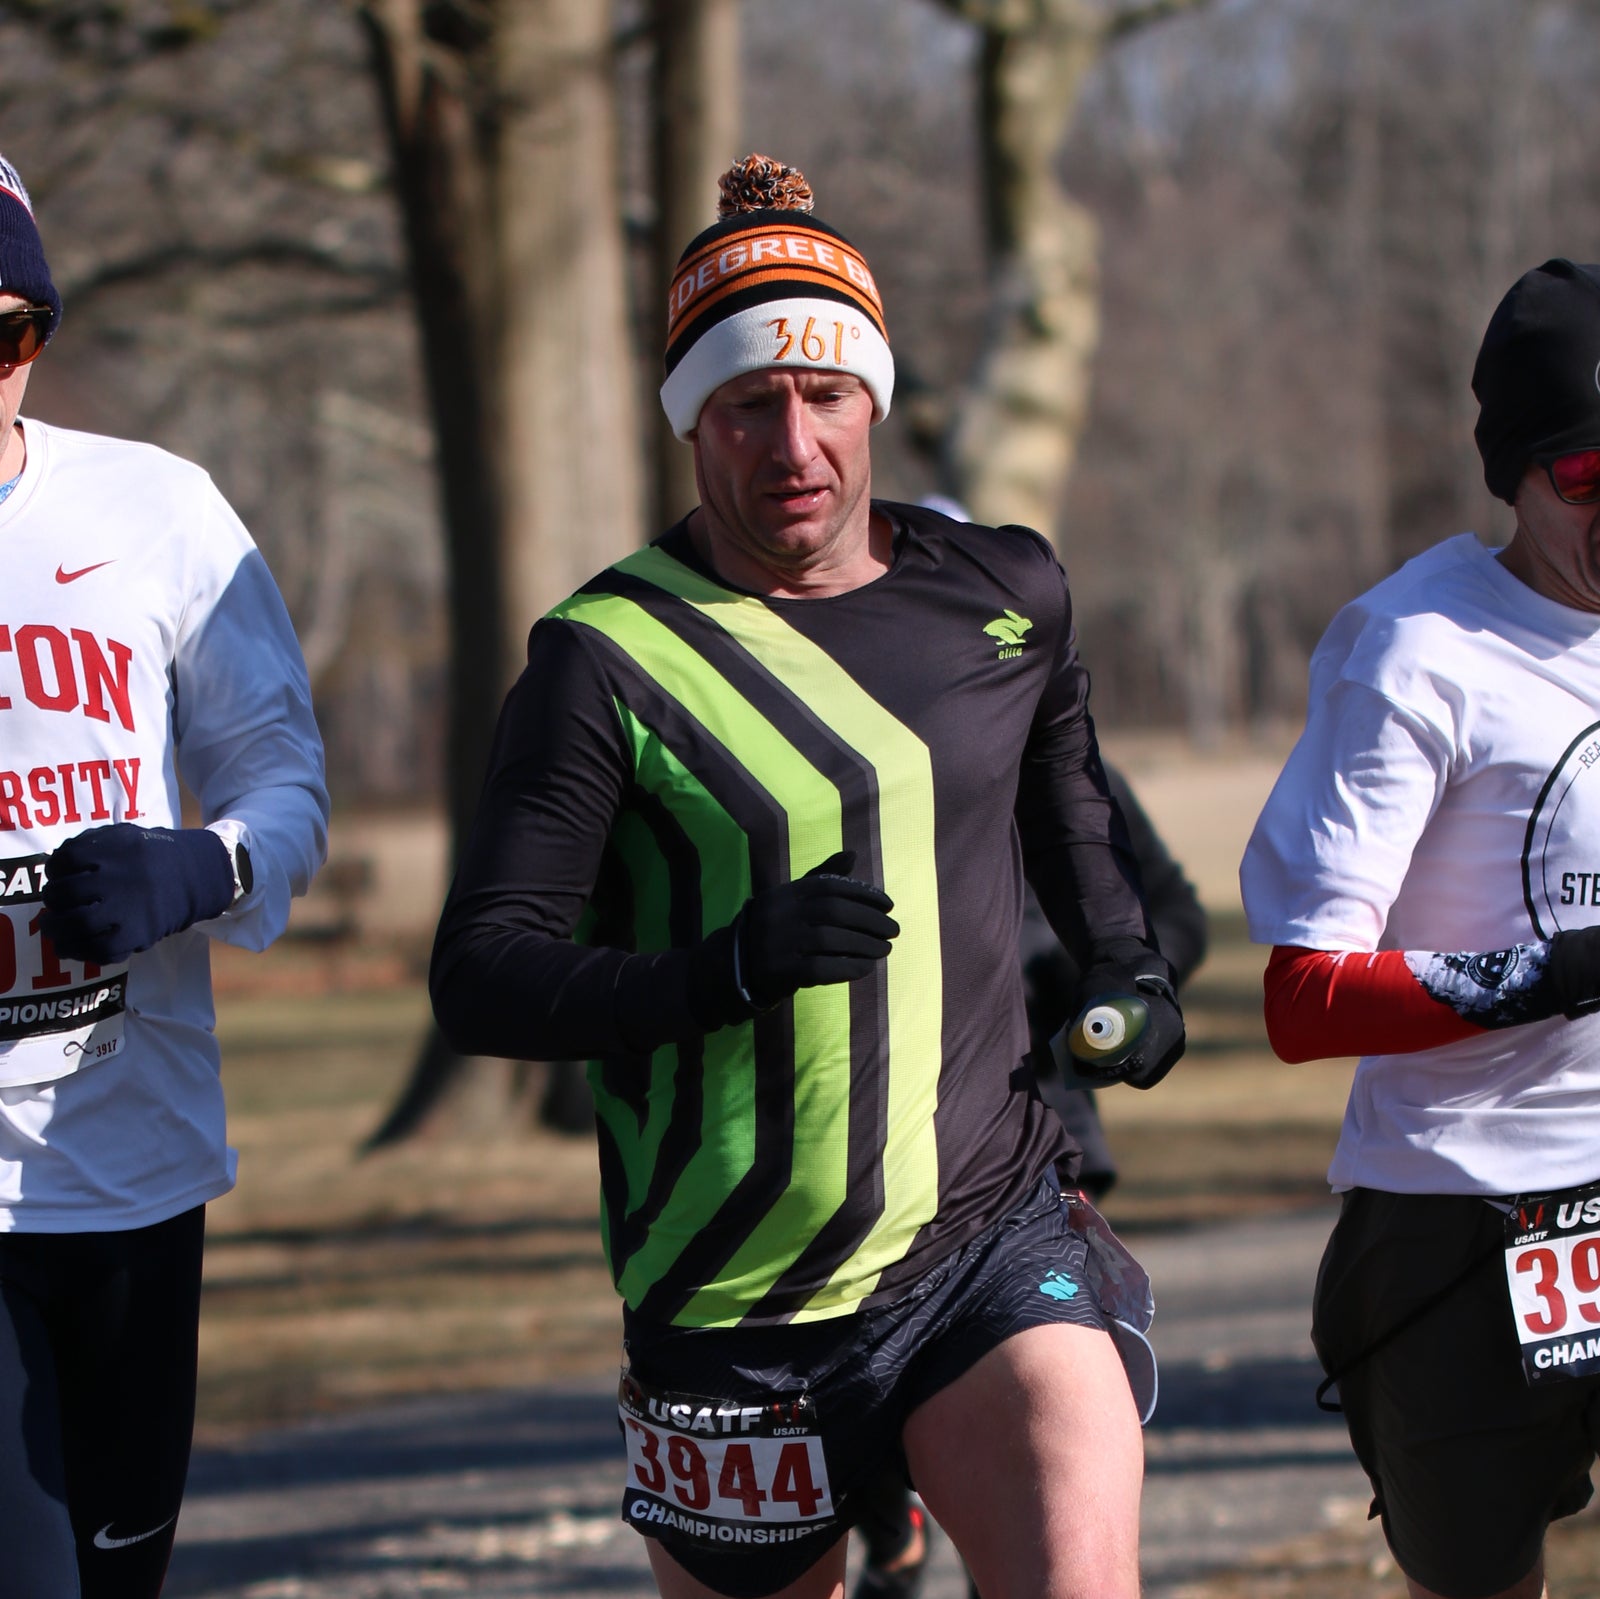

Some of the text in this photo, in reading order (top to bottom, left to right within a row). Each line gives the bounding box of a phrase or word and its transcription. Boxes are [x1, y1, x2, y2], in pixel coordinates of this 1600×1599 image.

[678, 236, 839, 310] DEGREE
[0, 624, 136, 733] ON
[0, 757, 141, 831] RSITY
[96, 1039, 118, 1057] 3917
[1514, 1230, 1549, 1246] USATF
[649, 1397, 763, 1433] USATF
[773, 1427, 809, 1437] USATF
[626, 1417, 824, 1517] 3944
